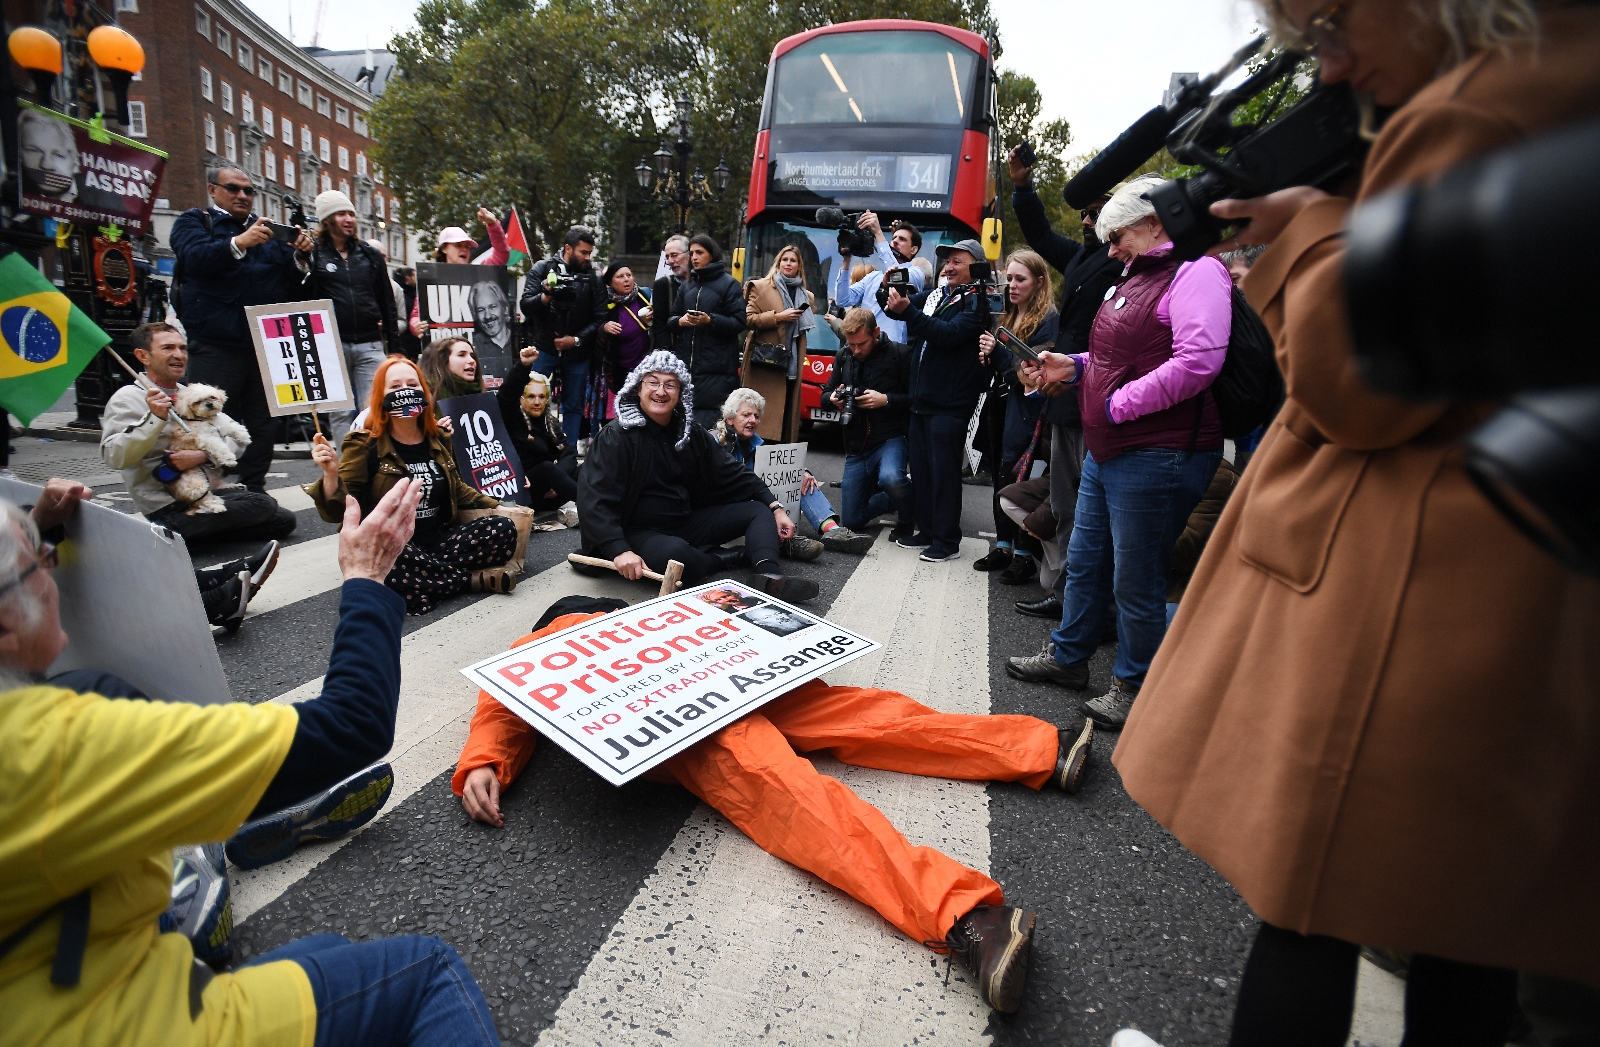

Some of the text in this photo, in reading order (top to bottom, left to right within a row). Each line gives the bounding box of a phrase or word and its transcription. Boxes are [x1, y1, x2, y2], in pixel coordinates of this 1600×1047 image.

[81, 151, 143, 181] HANDS
[785, 161, 882, 177] Northumberland Park
[908, 161, 940, 189] 341
[788, 178, 877, 187] ANGEL ROAD SUPERSTORES
[22, 197, 63, 213] DON'T
[65, 206, 106, 221] SHOOT
[106, 214, 127, 226] THE
[426, 284, 475, 323] UK
[275, 319, 303, 401] FREE
[297, 316, 322, 400] ASSANGE
[391, 398, 422, 407] ASSANGE
[395, 389, 415, 398] FREE
[814, 409, 838, 419] LF67
[459, 410, 494, 446] 10
[466, 440, 502, 459] YEARS
[769, 449, 798, 466] FREE
[470, 451, 506, 469] ENOUGH
[481, 470, 509, 486] Assange
[484, 465, 500, 476] Free
[761, 469, 802, 488] ASSANGE
[481, 478, 518, 498] NOW
[786, 488, 800, 503] THE
[497, 602, 703, 687] Political
[528, 618, 741, 711] Prisoner
[563, 634, 755, 722] TORTURED BY UK GOVT
[581, 648, 760, 736] NO EXTRADITION
[603, 635, 855, 761] Julian Assange
